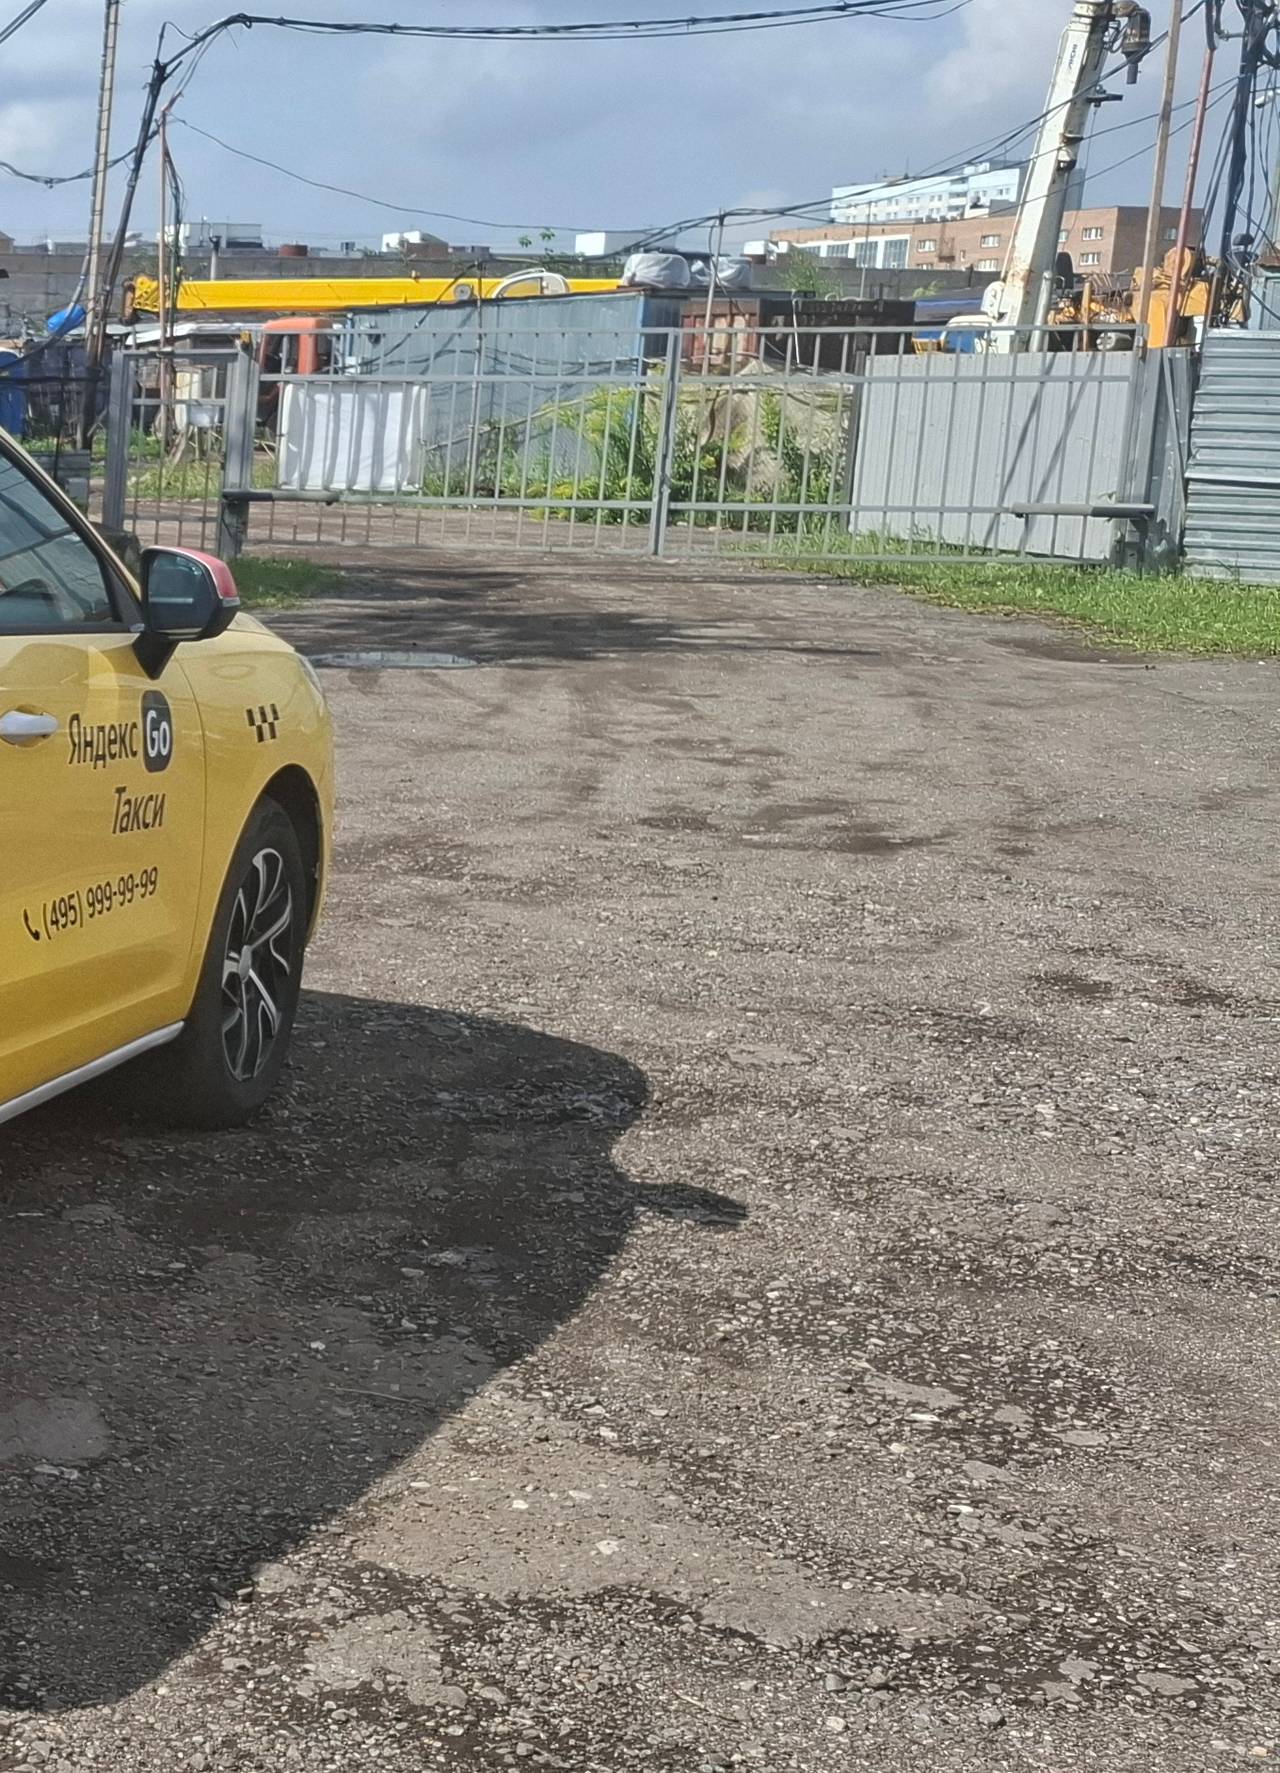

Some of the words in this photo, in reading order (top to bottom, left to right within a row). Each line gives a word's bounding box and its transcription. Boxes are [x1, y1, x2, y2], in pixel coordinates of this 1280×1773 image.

[68, 713, 139, 770] Яндекс
[146, 709, 171, 757] Go
[112, 785, 167, 835] Такси
[42, 889, 84, 941] (495)
[86, 865, 159, 920] 999-99-99
